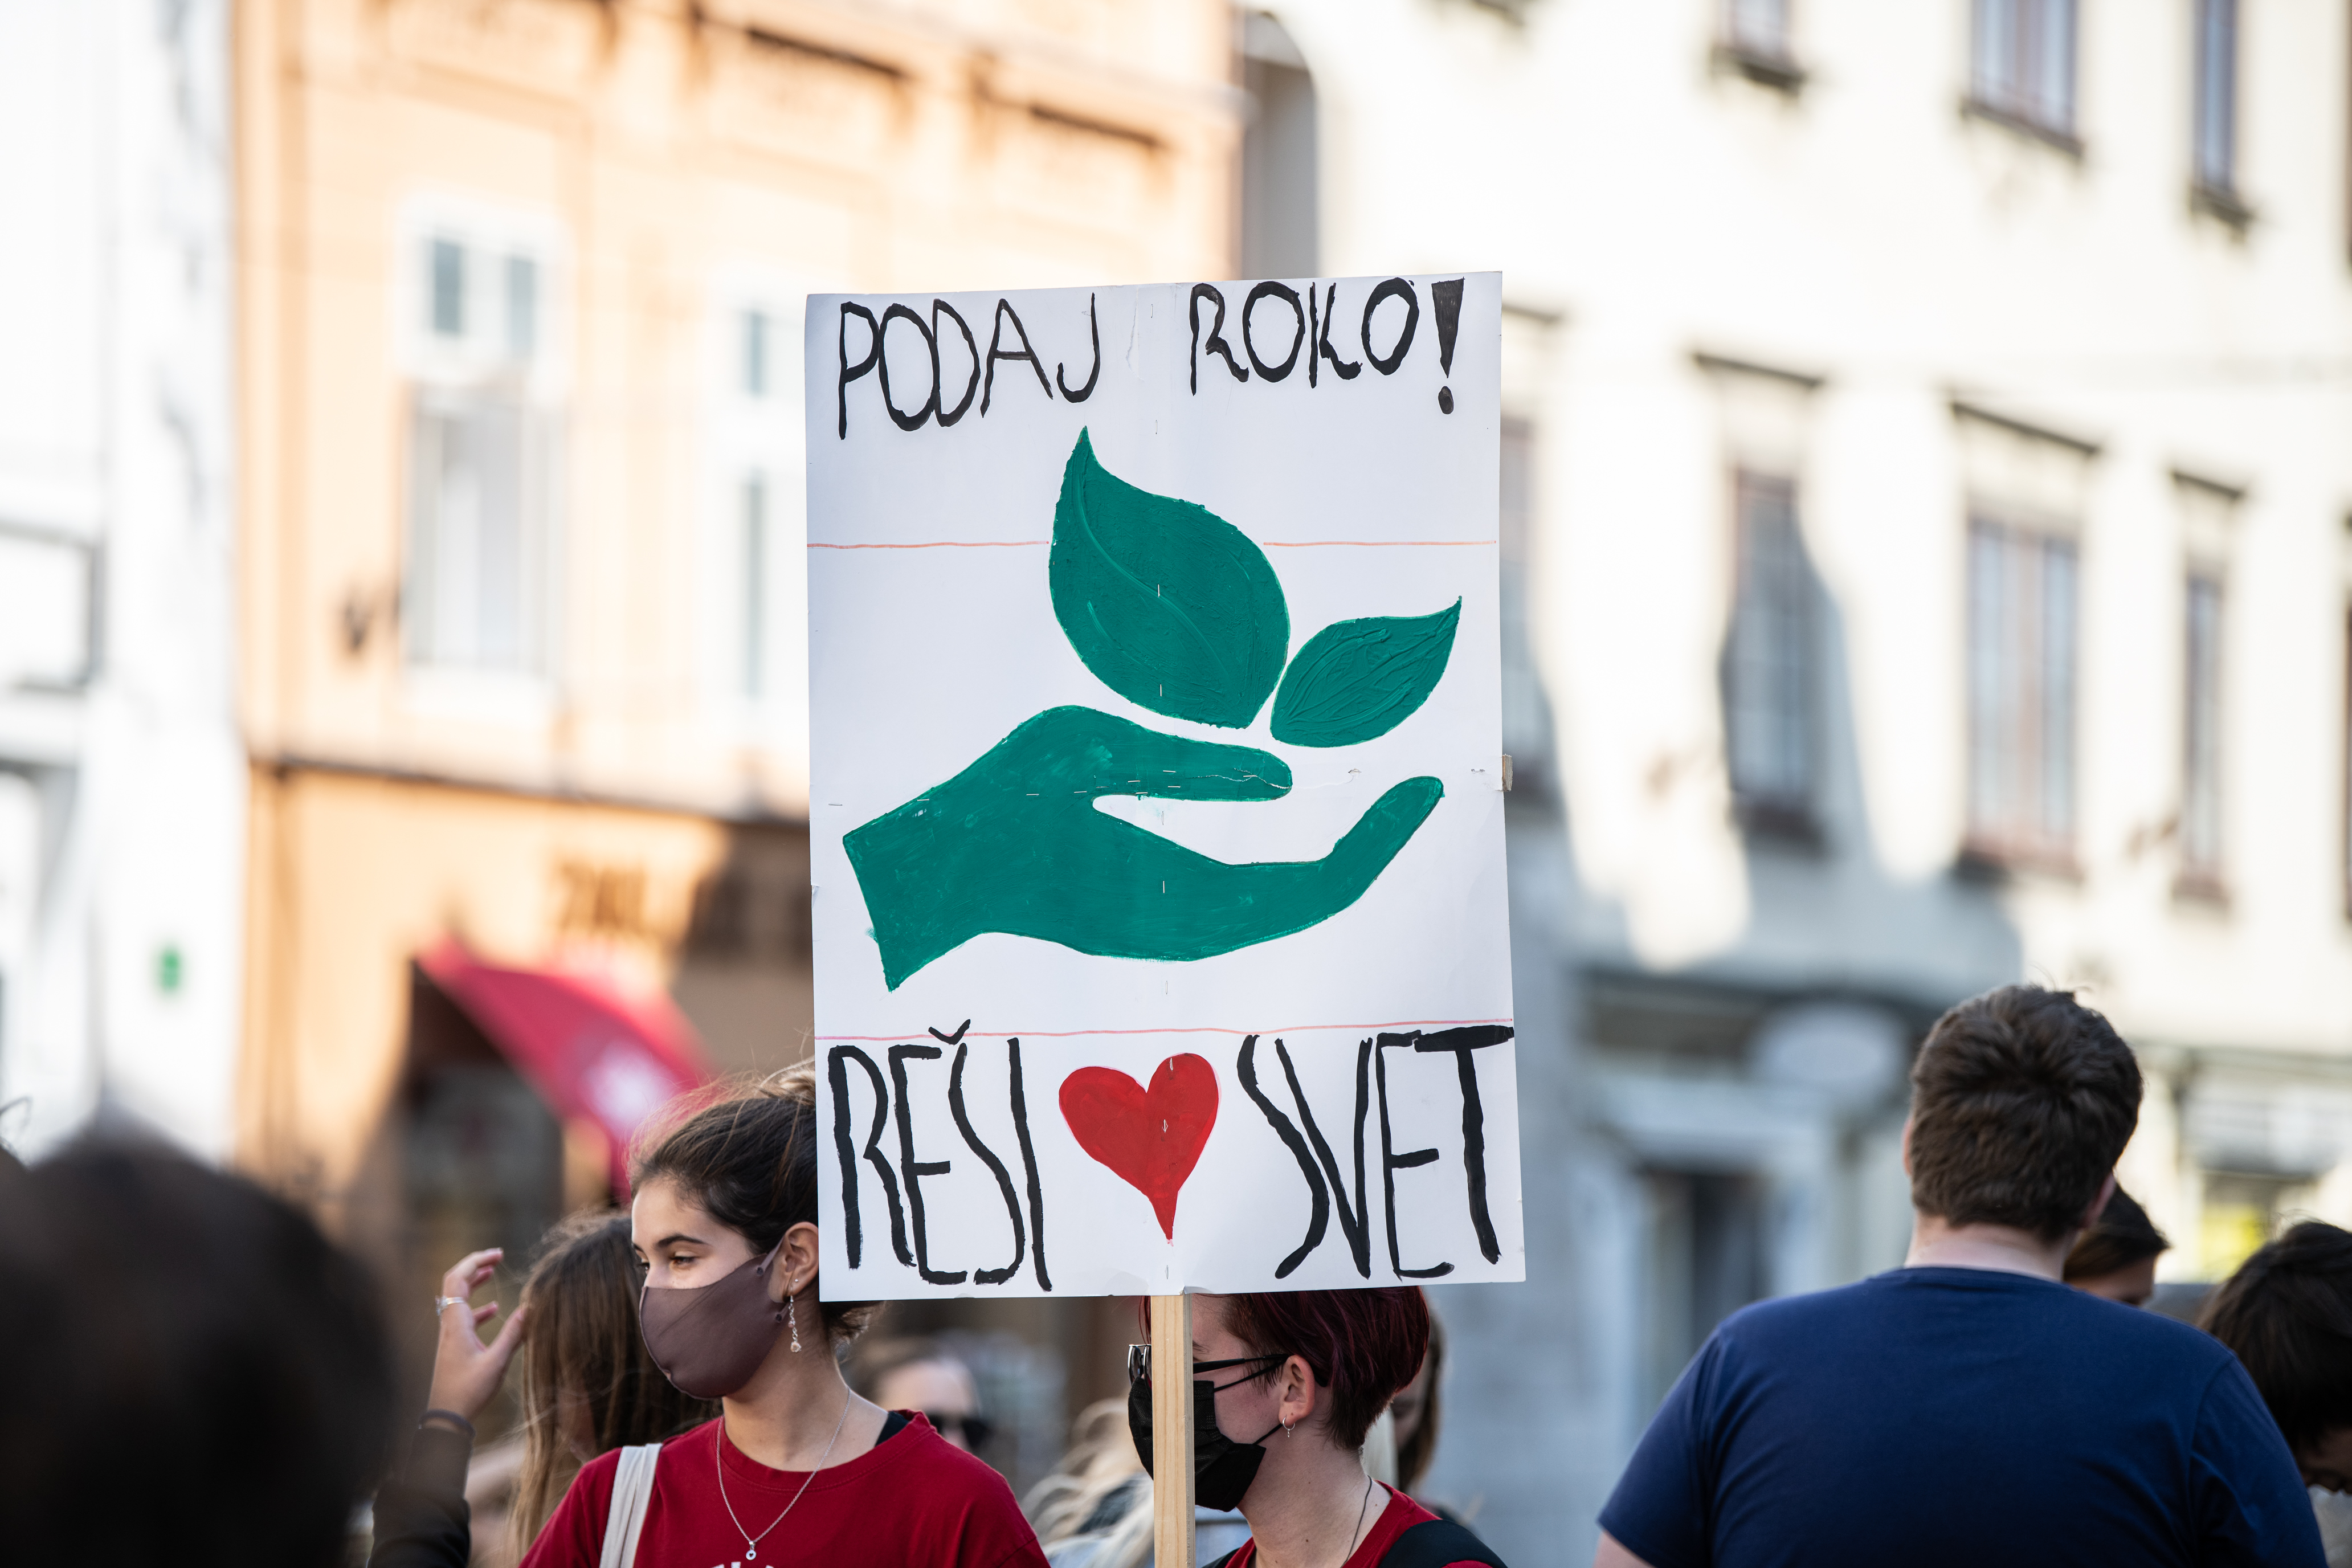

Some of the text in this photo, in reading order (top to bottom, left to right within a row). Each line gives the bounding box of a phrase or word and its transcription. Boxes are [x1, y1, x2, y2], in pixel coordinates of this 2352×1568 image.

[838, 276, 1465, 441] PODAJ ROKO!
[827, 1019, 1515, 1292] REŠI SVET
